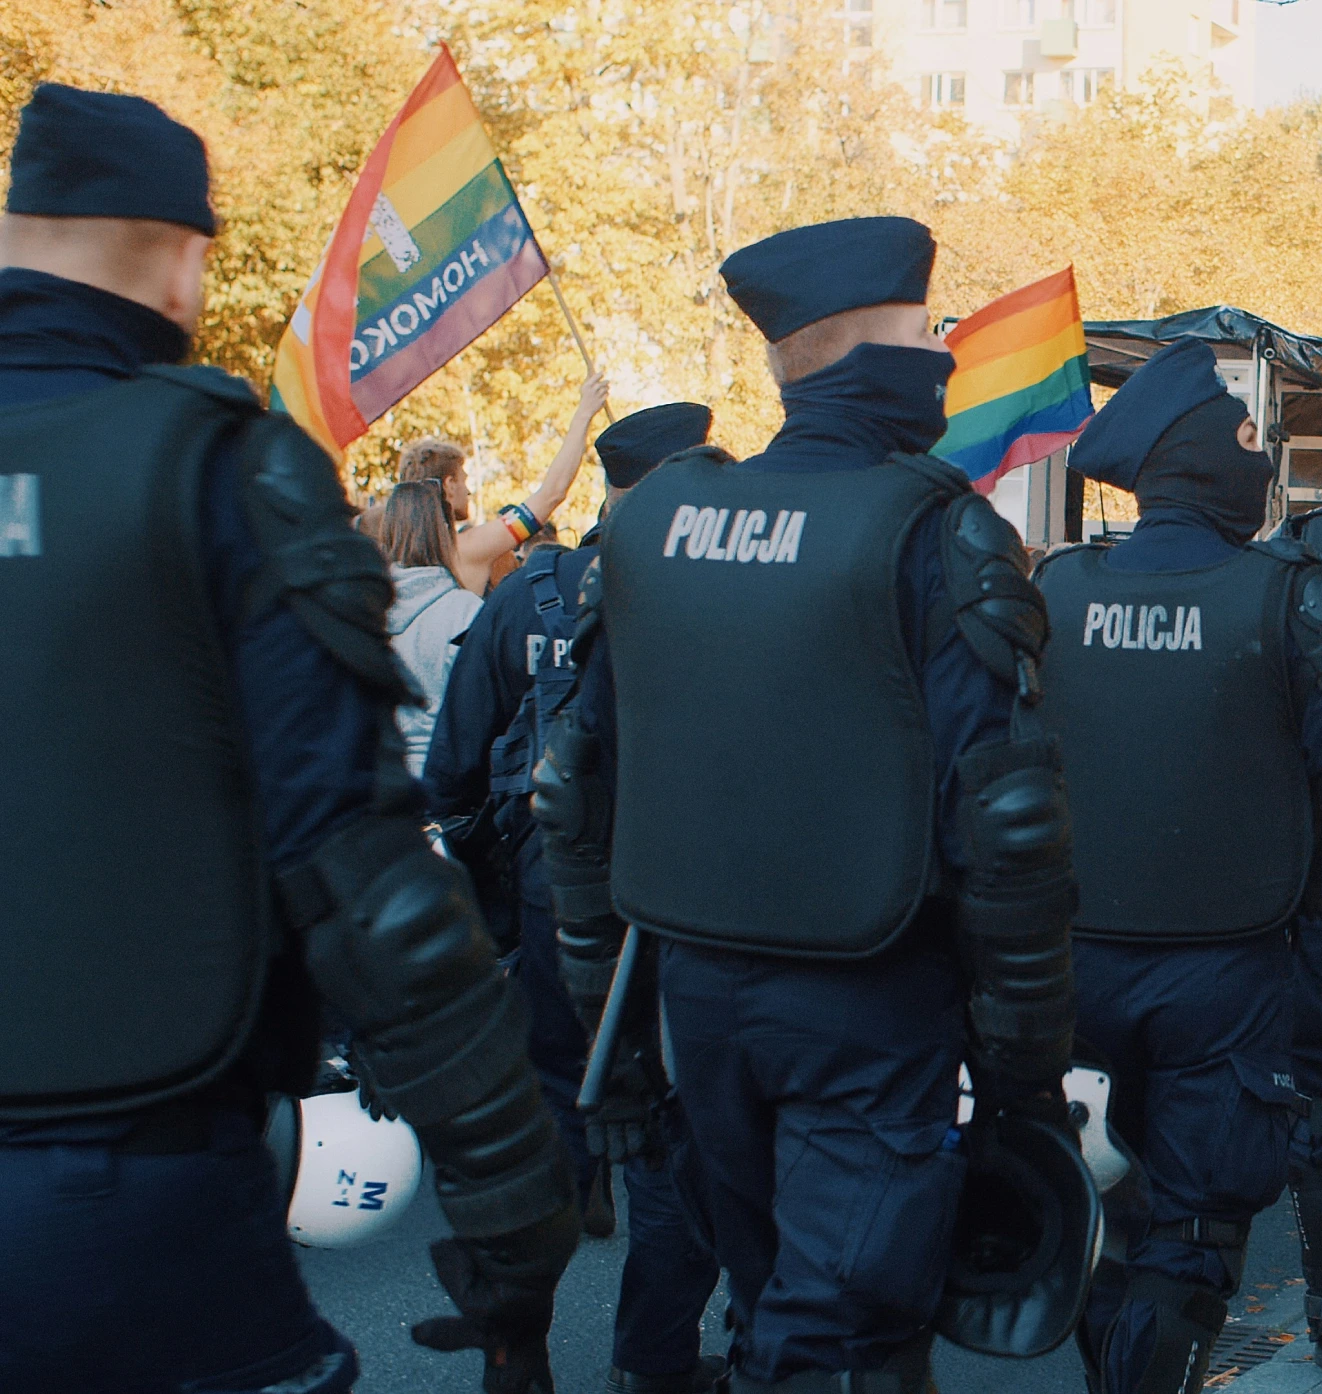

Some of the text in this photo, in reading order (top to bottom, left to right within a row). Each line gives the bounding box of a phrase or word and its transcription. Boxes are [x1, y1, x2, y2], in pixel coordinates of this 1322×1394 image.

[663, 504, 807, 563] POLICJA
[1083, 602, 1202, 651] POLICJA
[357, 1181, 388, 1210] M
